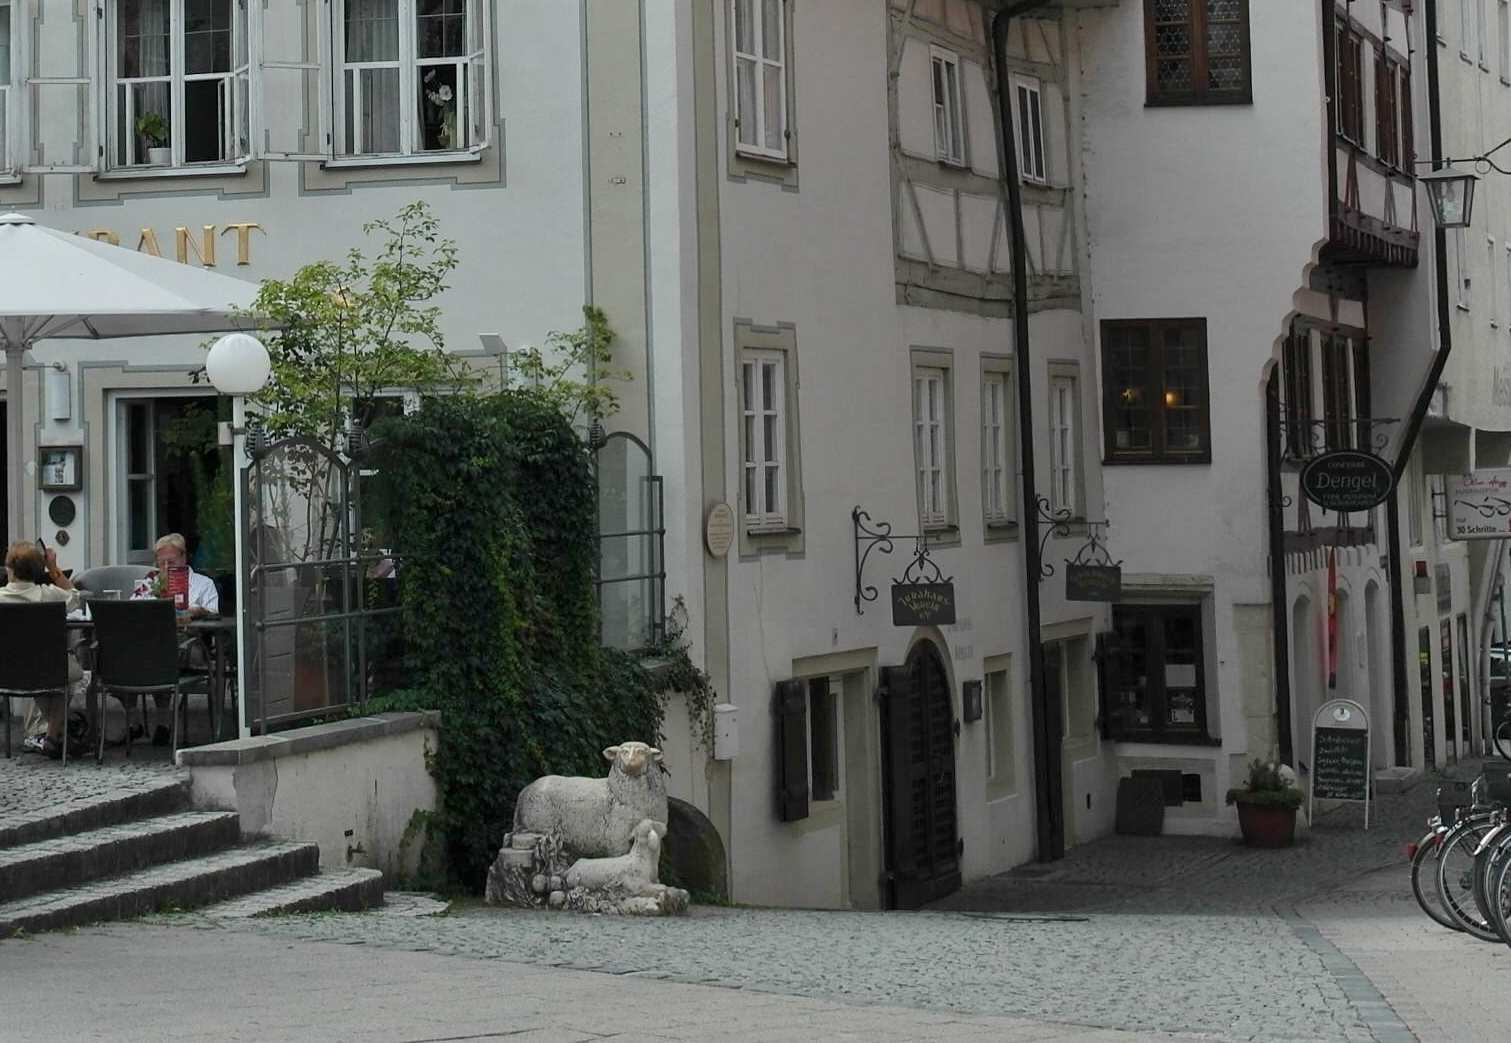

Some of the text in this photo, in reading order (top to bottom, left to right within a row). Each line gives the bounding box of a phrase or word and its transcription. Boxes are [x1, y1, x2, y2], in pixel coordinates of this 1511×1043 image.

[1316, 472, 1377, 492] Dengel
[1456, 524, 1497, 534] 30 Schritte
